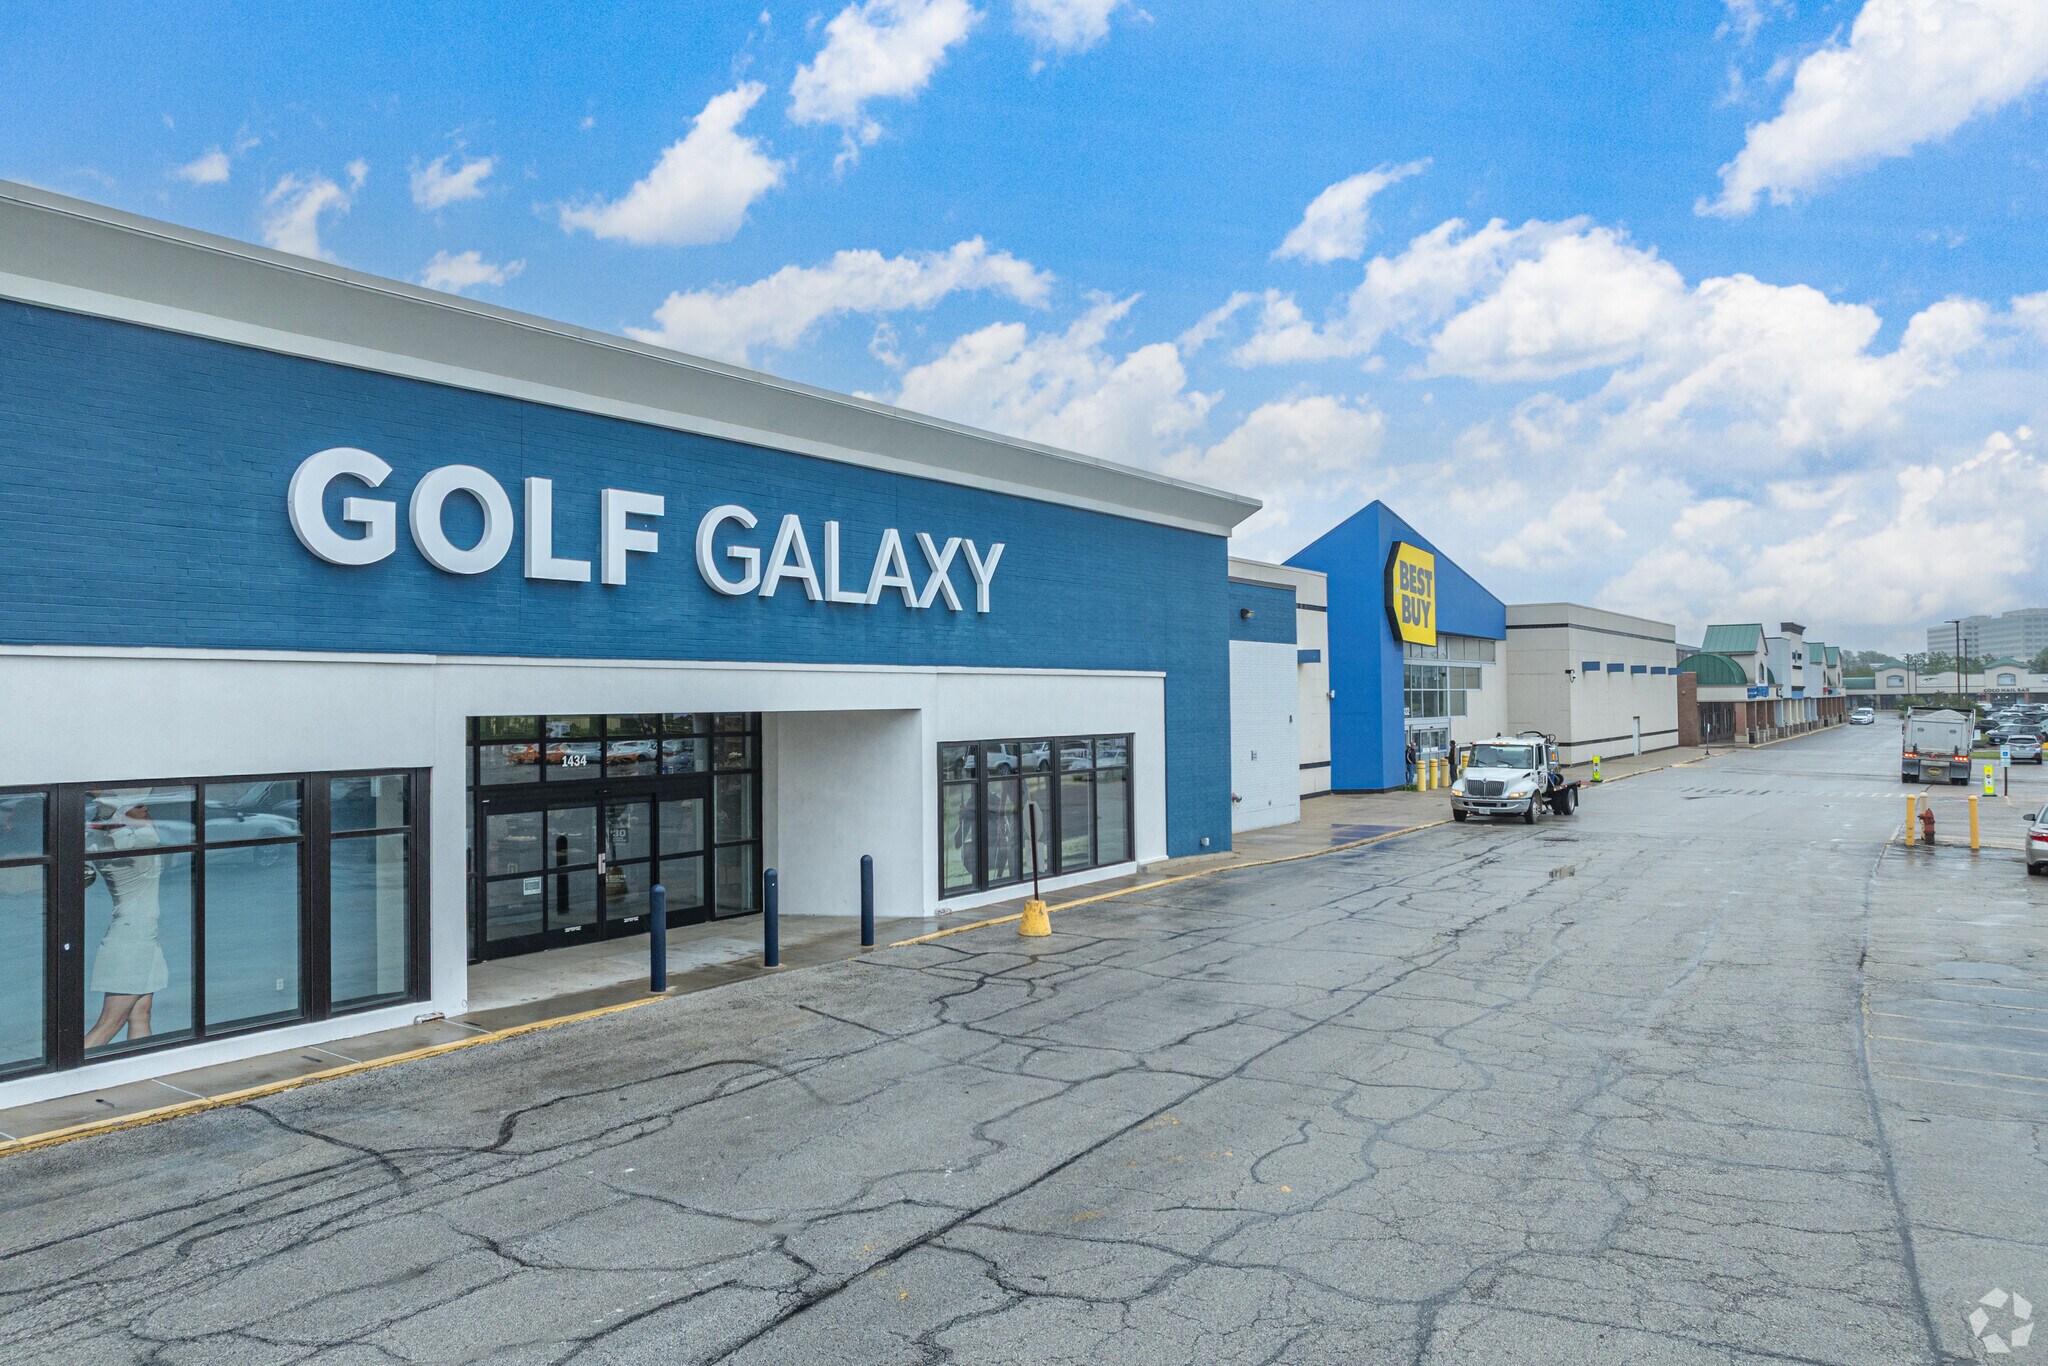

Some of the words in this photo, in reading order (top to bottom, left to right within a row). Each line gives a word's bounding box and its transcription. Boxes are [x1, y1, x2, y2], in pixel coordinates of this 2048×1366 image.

[288, 447, 665, 585] GOLF
[696, 504, 1005, 612] GALAXY
[1399, 559, 1432, 598] BEST
[1401, 594, 1431, 628] BUY
[562, 754, 587, 767] 1434
